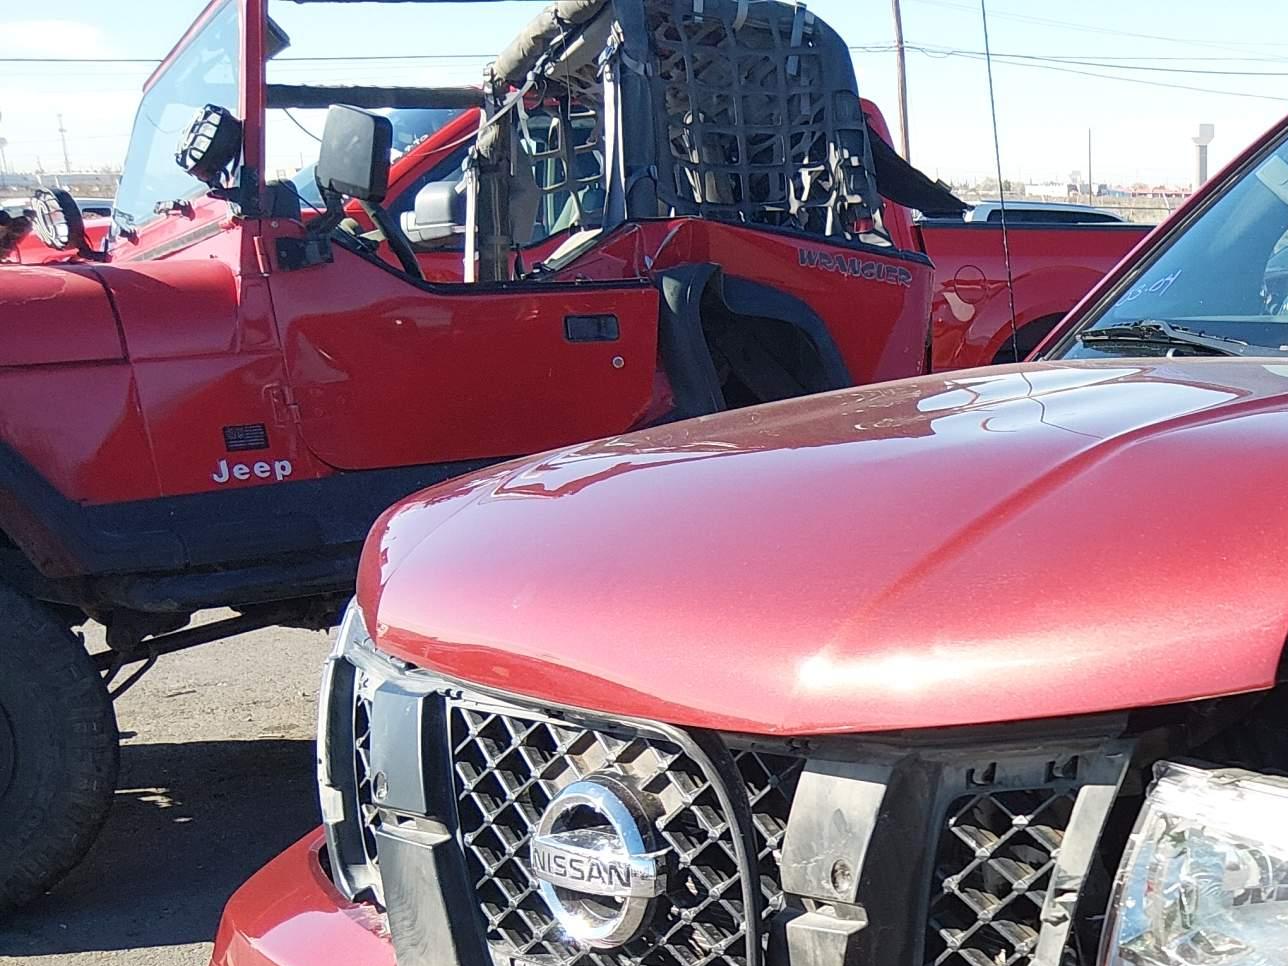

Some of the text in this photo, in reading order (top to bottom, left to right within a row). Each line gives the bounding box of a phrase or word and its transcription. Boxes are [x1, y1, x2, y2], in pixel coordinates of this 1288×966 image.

[797, 247, 913, 288] WRANGLER
[212, 459, 292, 483] Jeep
[532, 847, 632, 888] NISSAN
